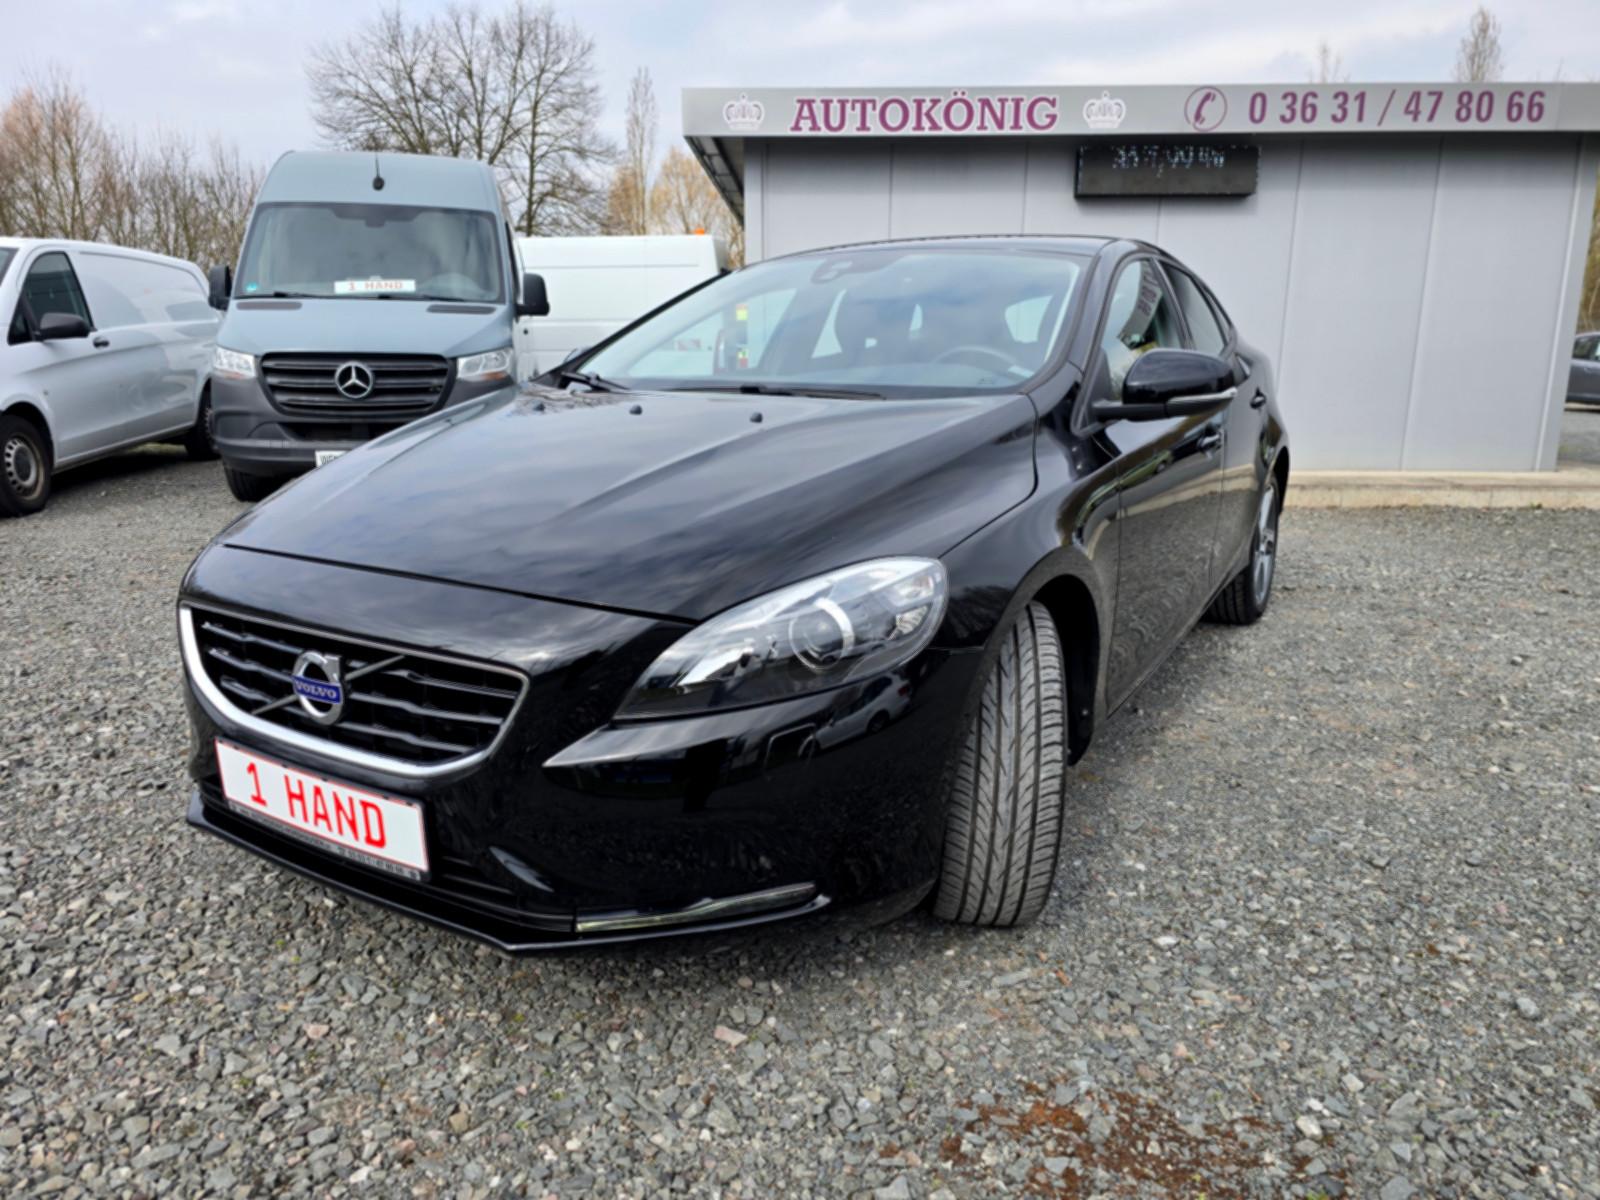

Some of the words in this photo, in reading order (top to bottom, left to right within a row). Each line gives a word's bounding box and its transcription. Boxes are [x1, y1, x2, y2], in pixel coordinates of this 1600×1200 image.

[789, 90, 1058, 133] AUTOKÖNIG
[1249, 92, 1267, 124] 0
[1279, 91, 1319, 124] 36
[1331, 91, 1367, 124] 31
[1403, 90, 1444, 123] 47
[1454, 90, 1495, 123] 80
[1505, 90, 1546, 123] 66
[363, 281, 404, 290] HAND
[295, 680, 337, 699] VOLVO
[246, 761, 268, 807] 1
[283, 773, 387, 850] HAND
